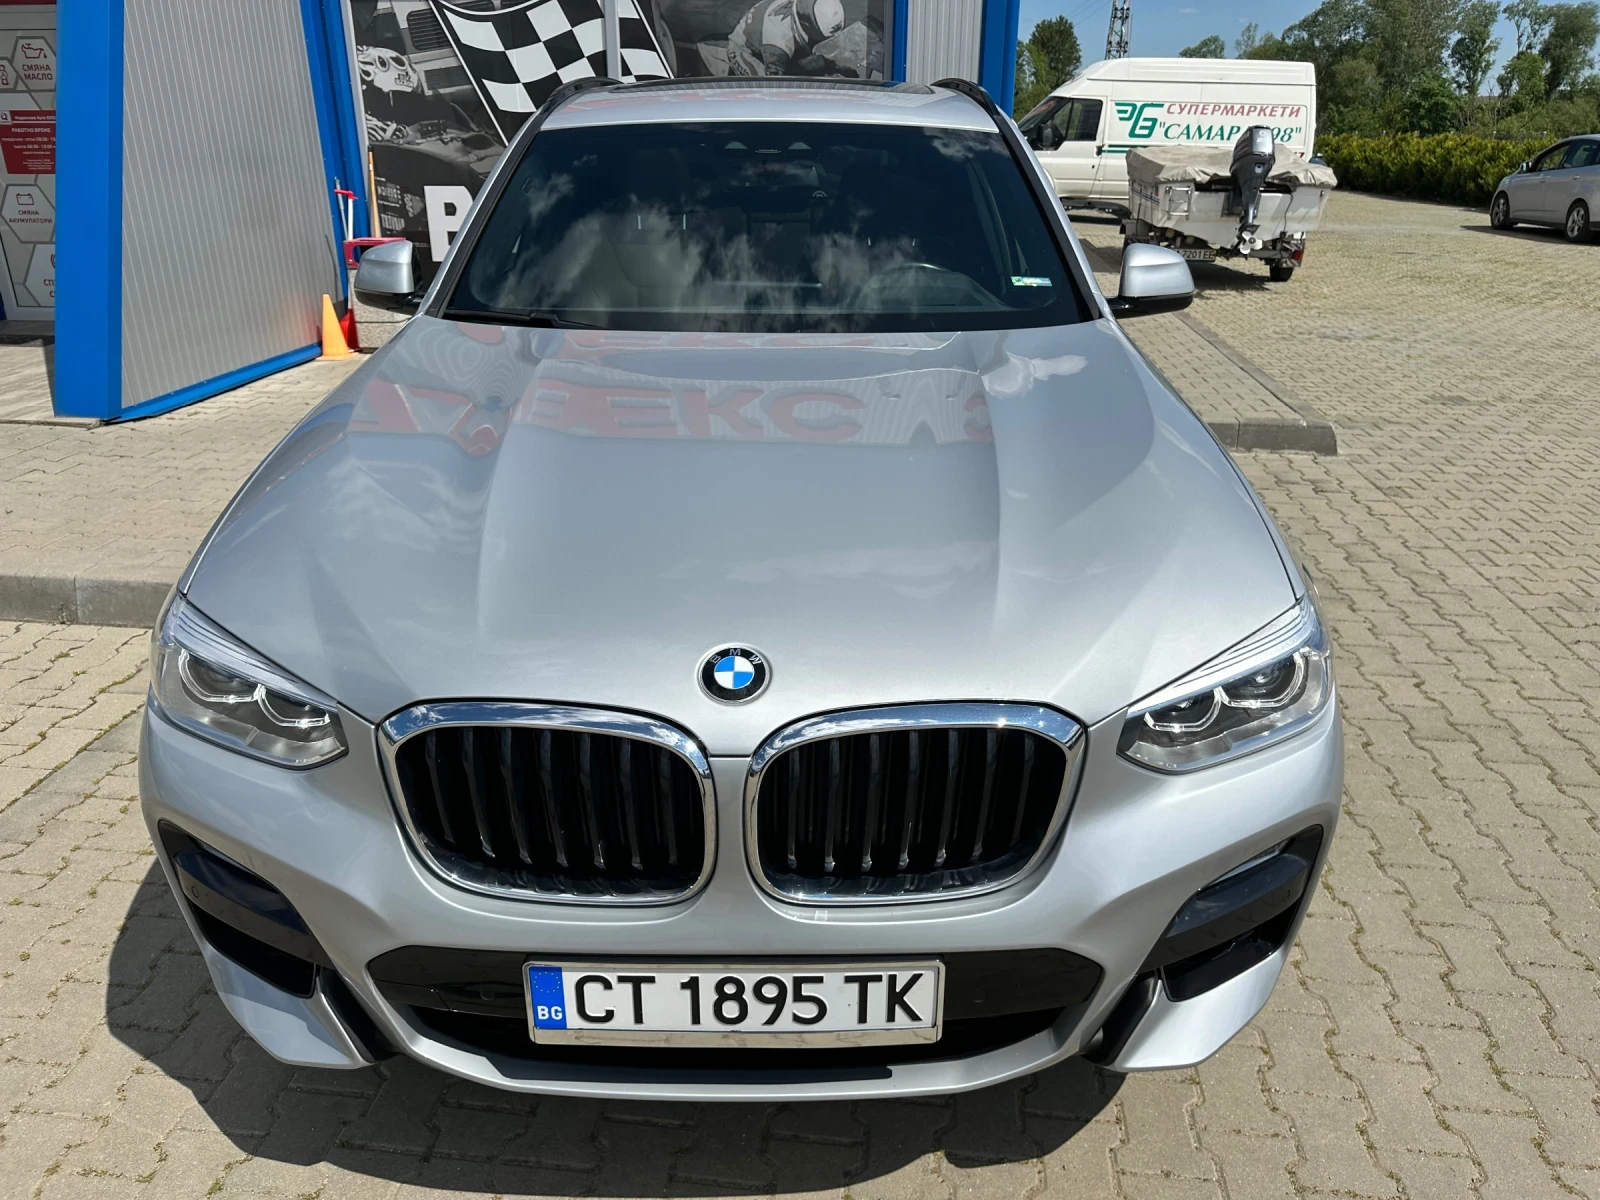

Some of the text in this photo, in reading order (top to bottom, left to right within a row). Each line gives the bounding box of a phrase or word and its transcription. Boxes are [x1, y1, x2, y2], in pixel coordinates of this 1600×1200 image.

[1167, 103, 1301, 118] СУПЕРМАРКЕТИ
[1159, 122, 1241, 141] "САМАР
[709, 648, 762, 665] BMW
[574, 973, 925, 1026] CT 1895 TK
[537, 1006, 563, 1021] BG
